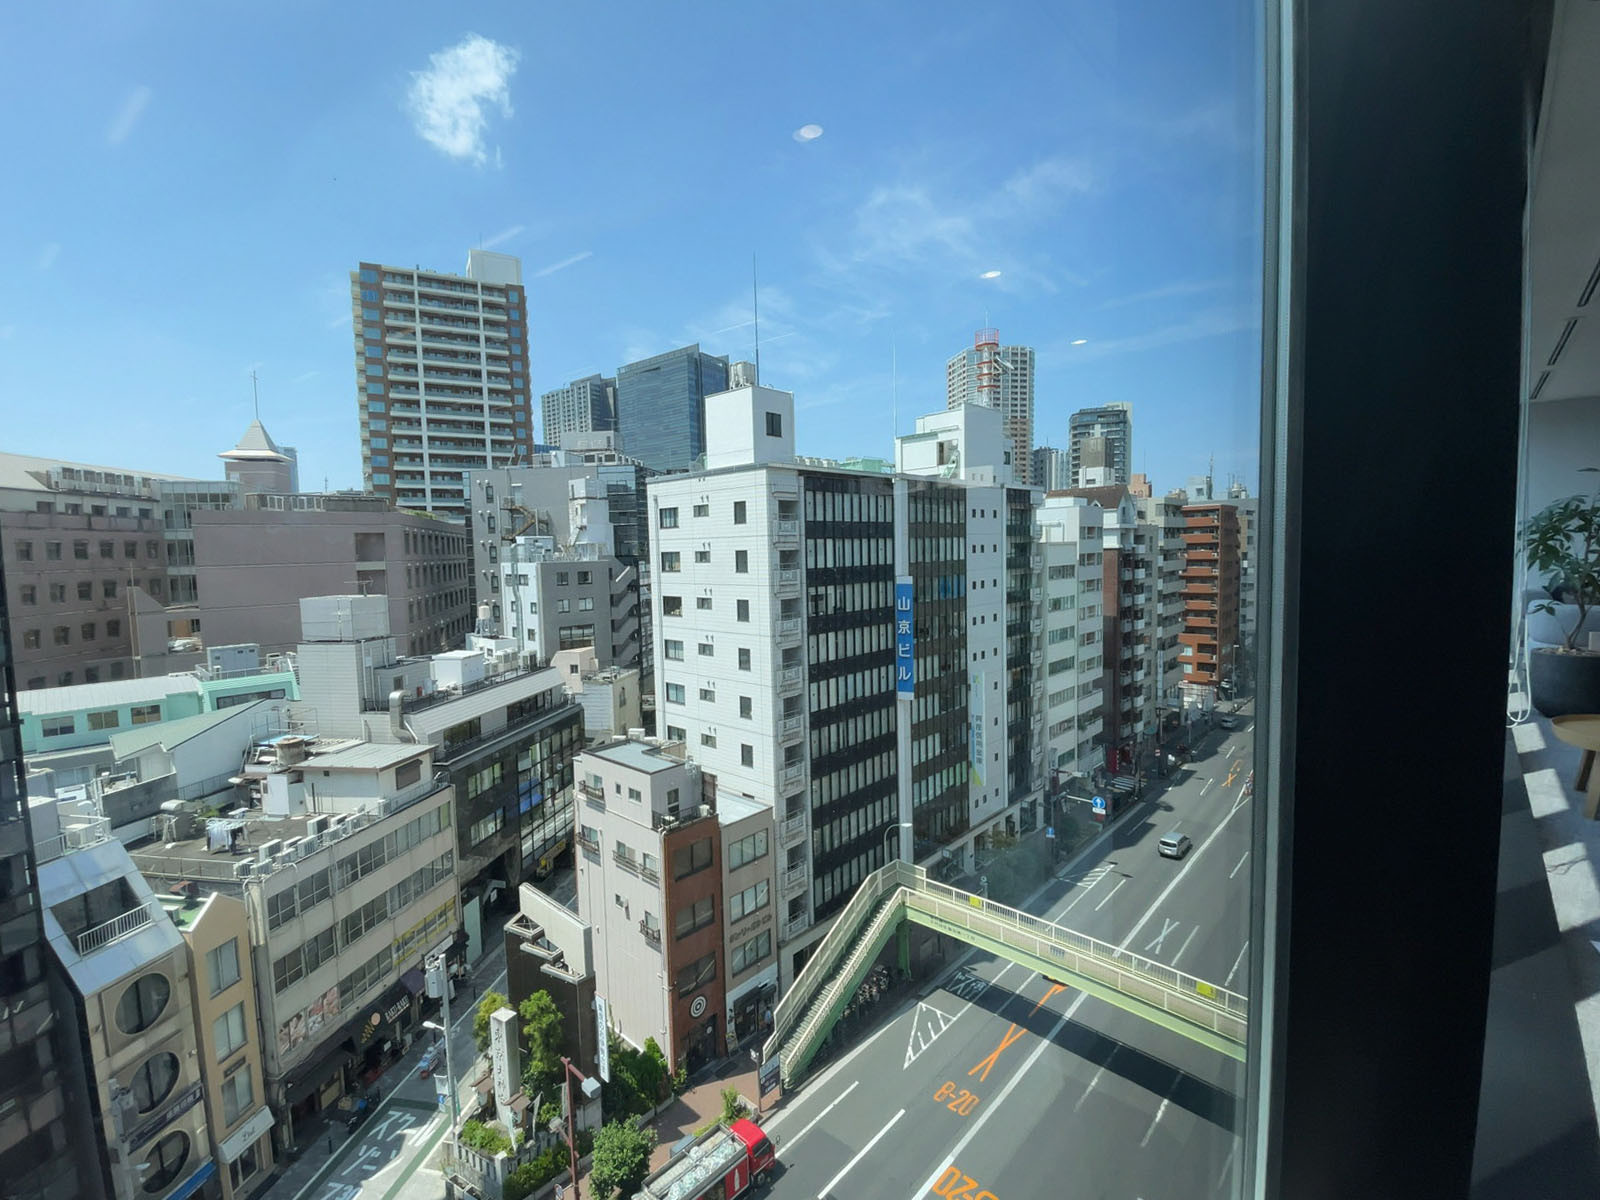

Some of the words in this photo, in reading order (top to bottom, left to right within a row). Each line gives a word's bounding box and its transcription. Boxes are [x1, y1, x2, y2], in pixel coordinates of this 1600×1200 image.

[897, 596, 912, 680] 山京ビル
[933, 1081, 979, 1116] 8-20
